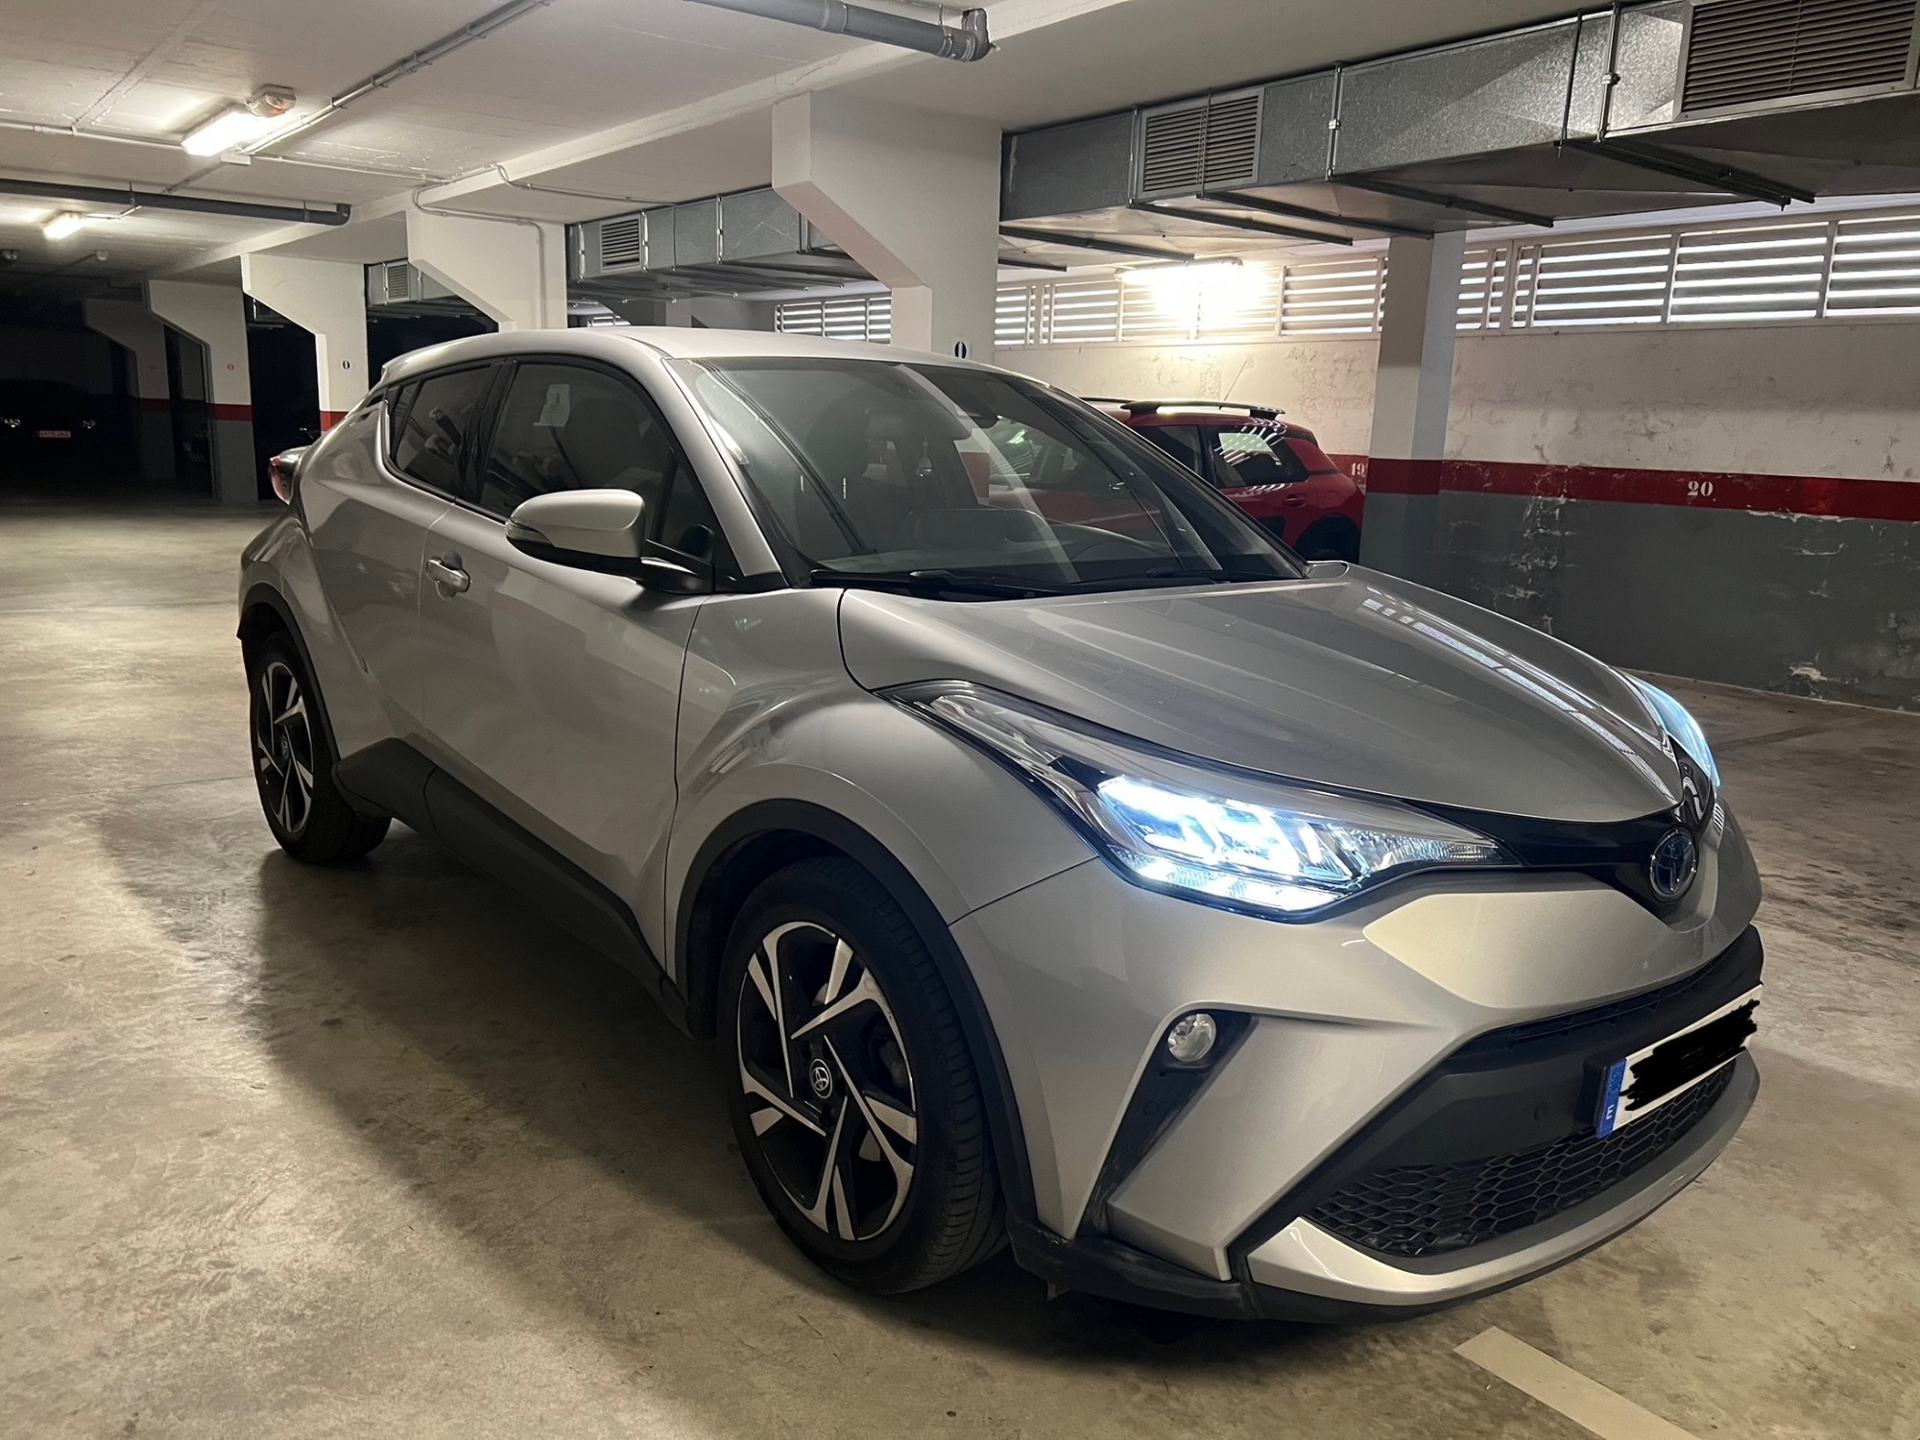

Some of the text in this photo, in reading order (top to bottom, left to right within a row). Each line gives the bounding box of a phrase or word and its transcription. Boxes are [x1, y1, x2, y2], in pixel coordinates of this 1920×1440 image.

[1350, 462, 1366, 476] 19
[1687, 480, 1714, 497] 20
[1605, 1103, 1615, 1120] E
